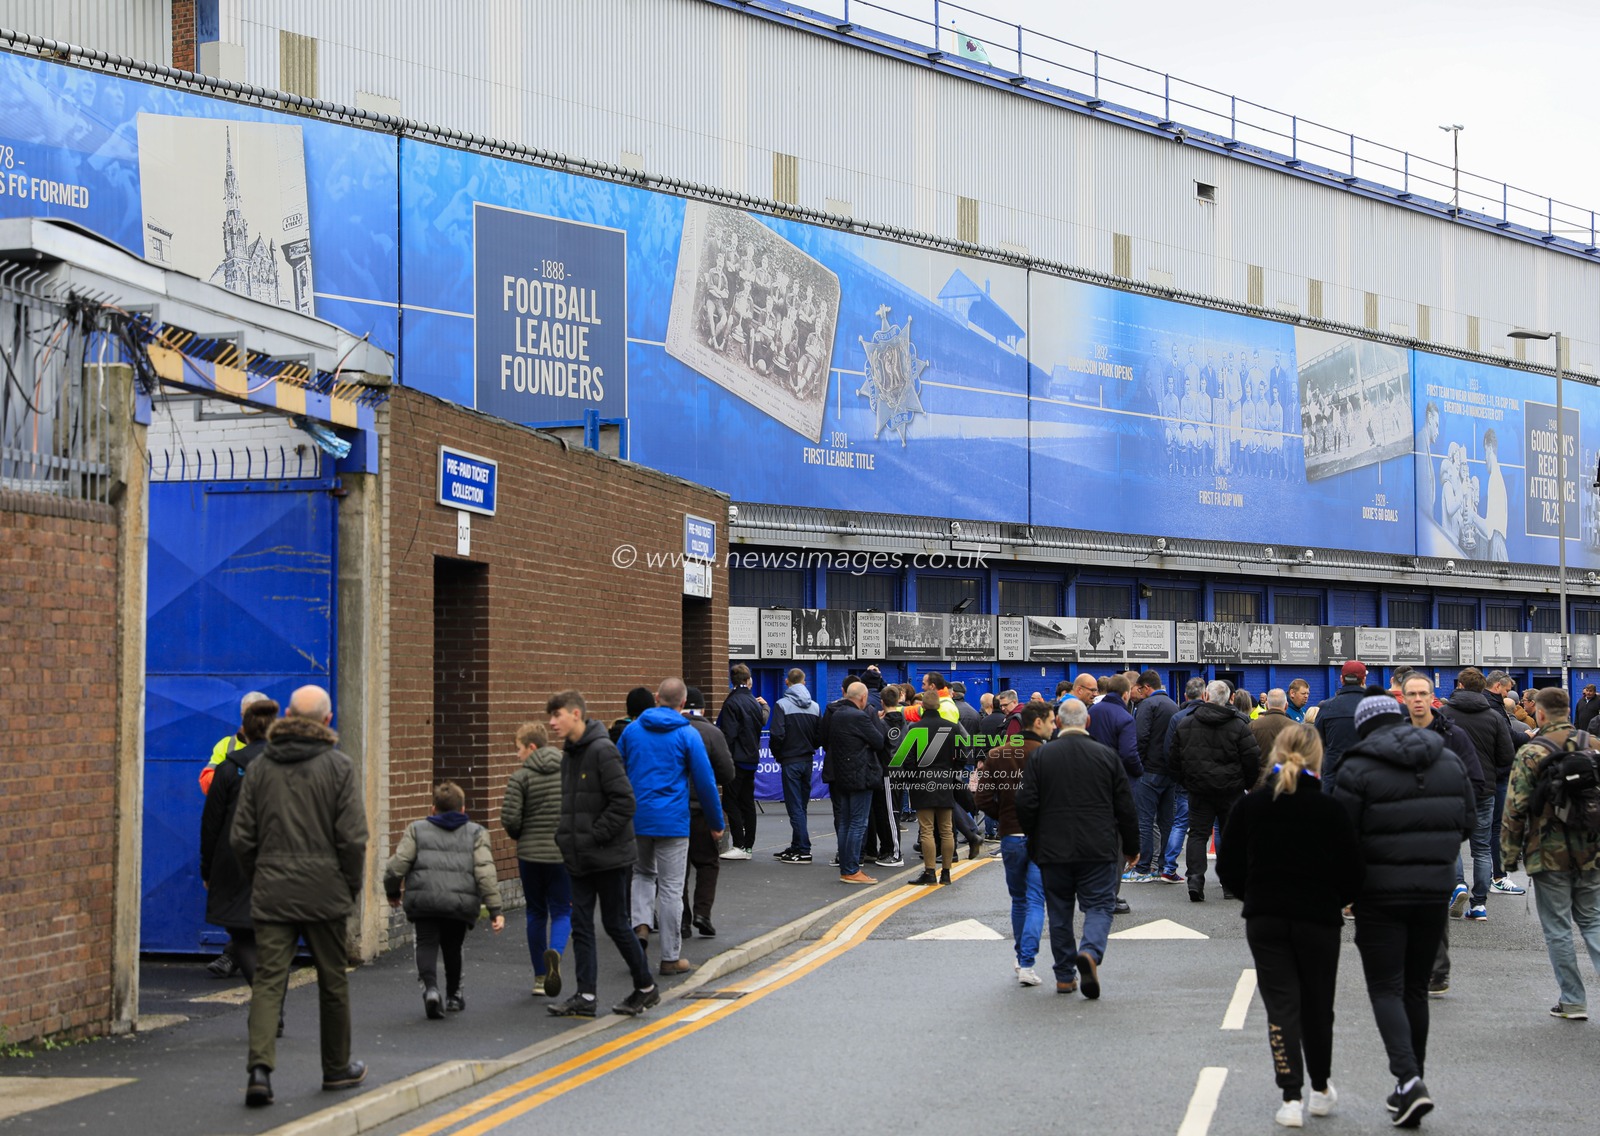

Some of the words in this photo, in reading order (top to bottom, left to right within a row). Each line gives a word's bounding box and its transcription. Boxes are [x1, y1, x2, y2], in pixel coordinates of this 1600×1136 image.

[9, 173, 28, 198] FC
[31, 177, 89, 209] FORMED
[503, 275, 602, 325] FOOTBALL
[515, 316, 590, 361] LEAGUE
[501, 354, 604, 402] FOUNDERS
[1098, 361, 1114, 378] PARK
[1114, 364, 1134, 381] OPENS
[1531, 429, 1575, 457] GOODISN'S
[803, 447, 825, 465] FIRST
[826, 449, 855, 469] LEAGUE
[855, 452, 875, 470] TITLE
[1538, 454, 1568, 479] RECOD
[446, 458, 471, 479] PRE-PAID
[471, 465, 490, 484] TICKET
[452, 481, 484, 504] COLLECTION
[1199, 490, 1214, 505] FIRST
[1214, 491, 1221, 506] FA
[1221, 492, 1232, 507] CUP
[1233, 493, 1244, 508] WIN
[1285, 631, 1294, 640] THE
[1294, 631, 1315, 640] EVERTON
[1290, 640, 1310, 649] TIMELINE
[766, 648, 774, 656] 59
[780, 649, 788, 657] 58
[862, 648, 868, 656] 57
